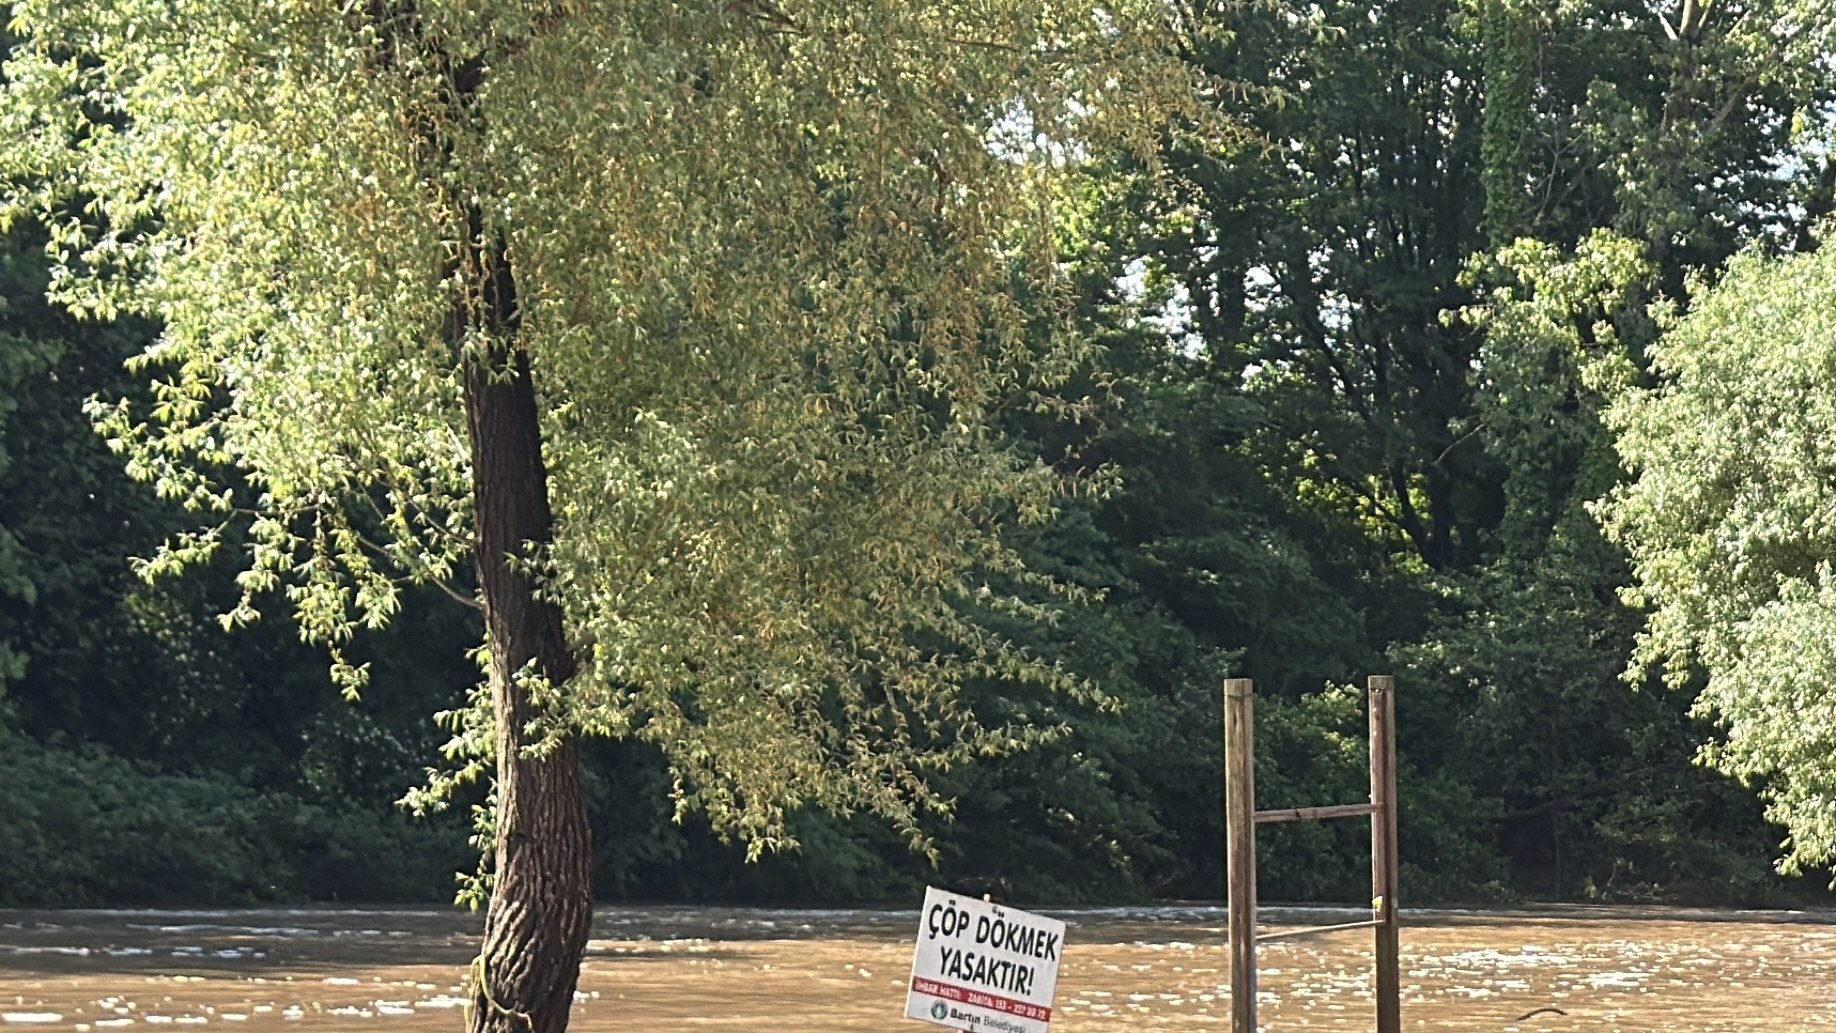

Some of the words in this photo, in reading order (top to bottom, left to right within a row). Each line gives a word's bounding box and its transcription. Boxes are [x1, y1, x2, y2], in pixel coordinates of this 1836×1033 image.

[929, 899, 969, 940] ÇÖP
[976, 912, 1058, 961] DÖKMEK
[941, 946, 1034, 996] YASAKTIR!
[984, 1016, 1026, 1033] Belediyesi
